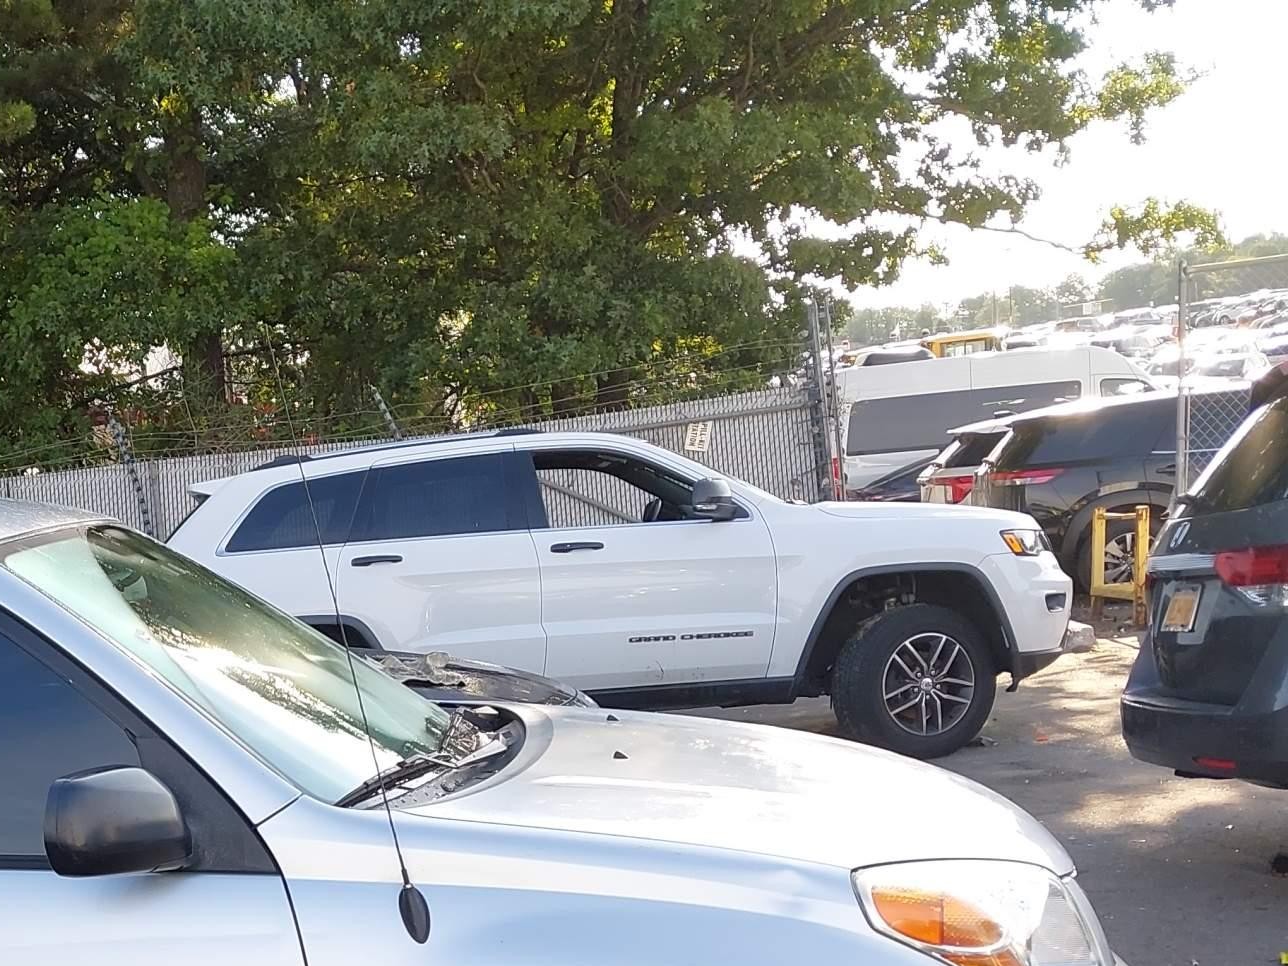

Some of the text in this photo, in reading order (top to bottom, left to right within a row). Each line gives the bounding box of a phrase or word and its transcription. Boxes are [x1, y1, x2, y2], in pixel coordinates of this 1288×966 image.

[688, 421, 699, 447] TATION
[698, 422, 708, 449] PILL-KIT
[629, 630, 754, 643] GRAND CHEROKEE
